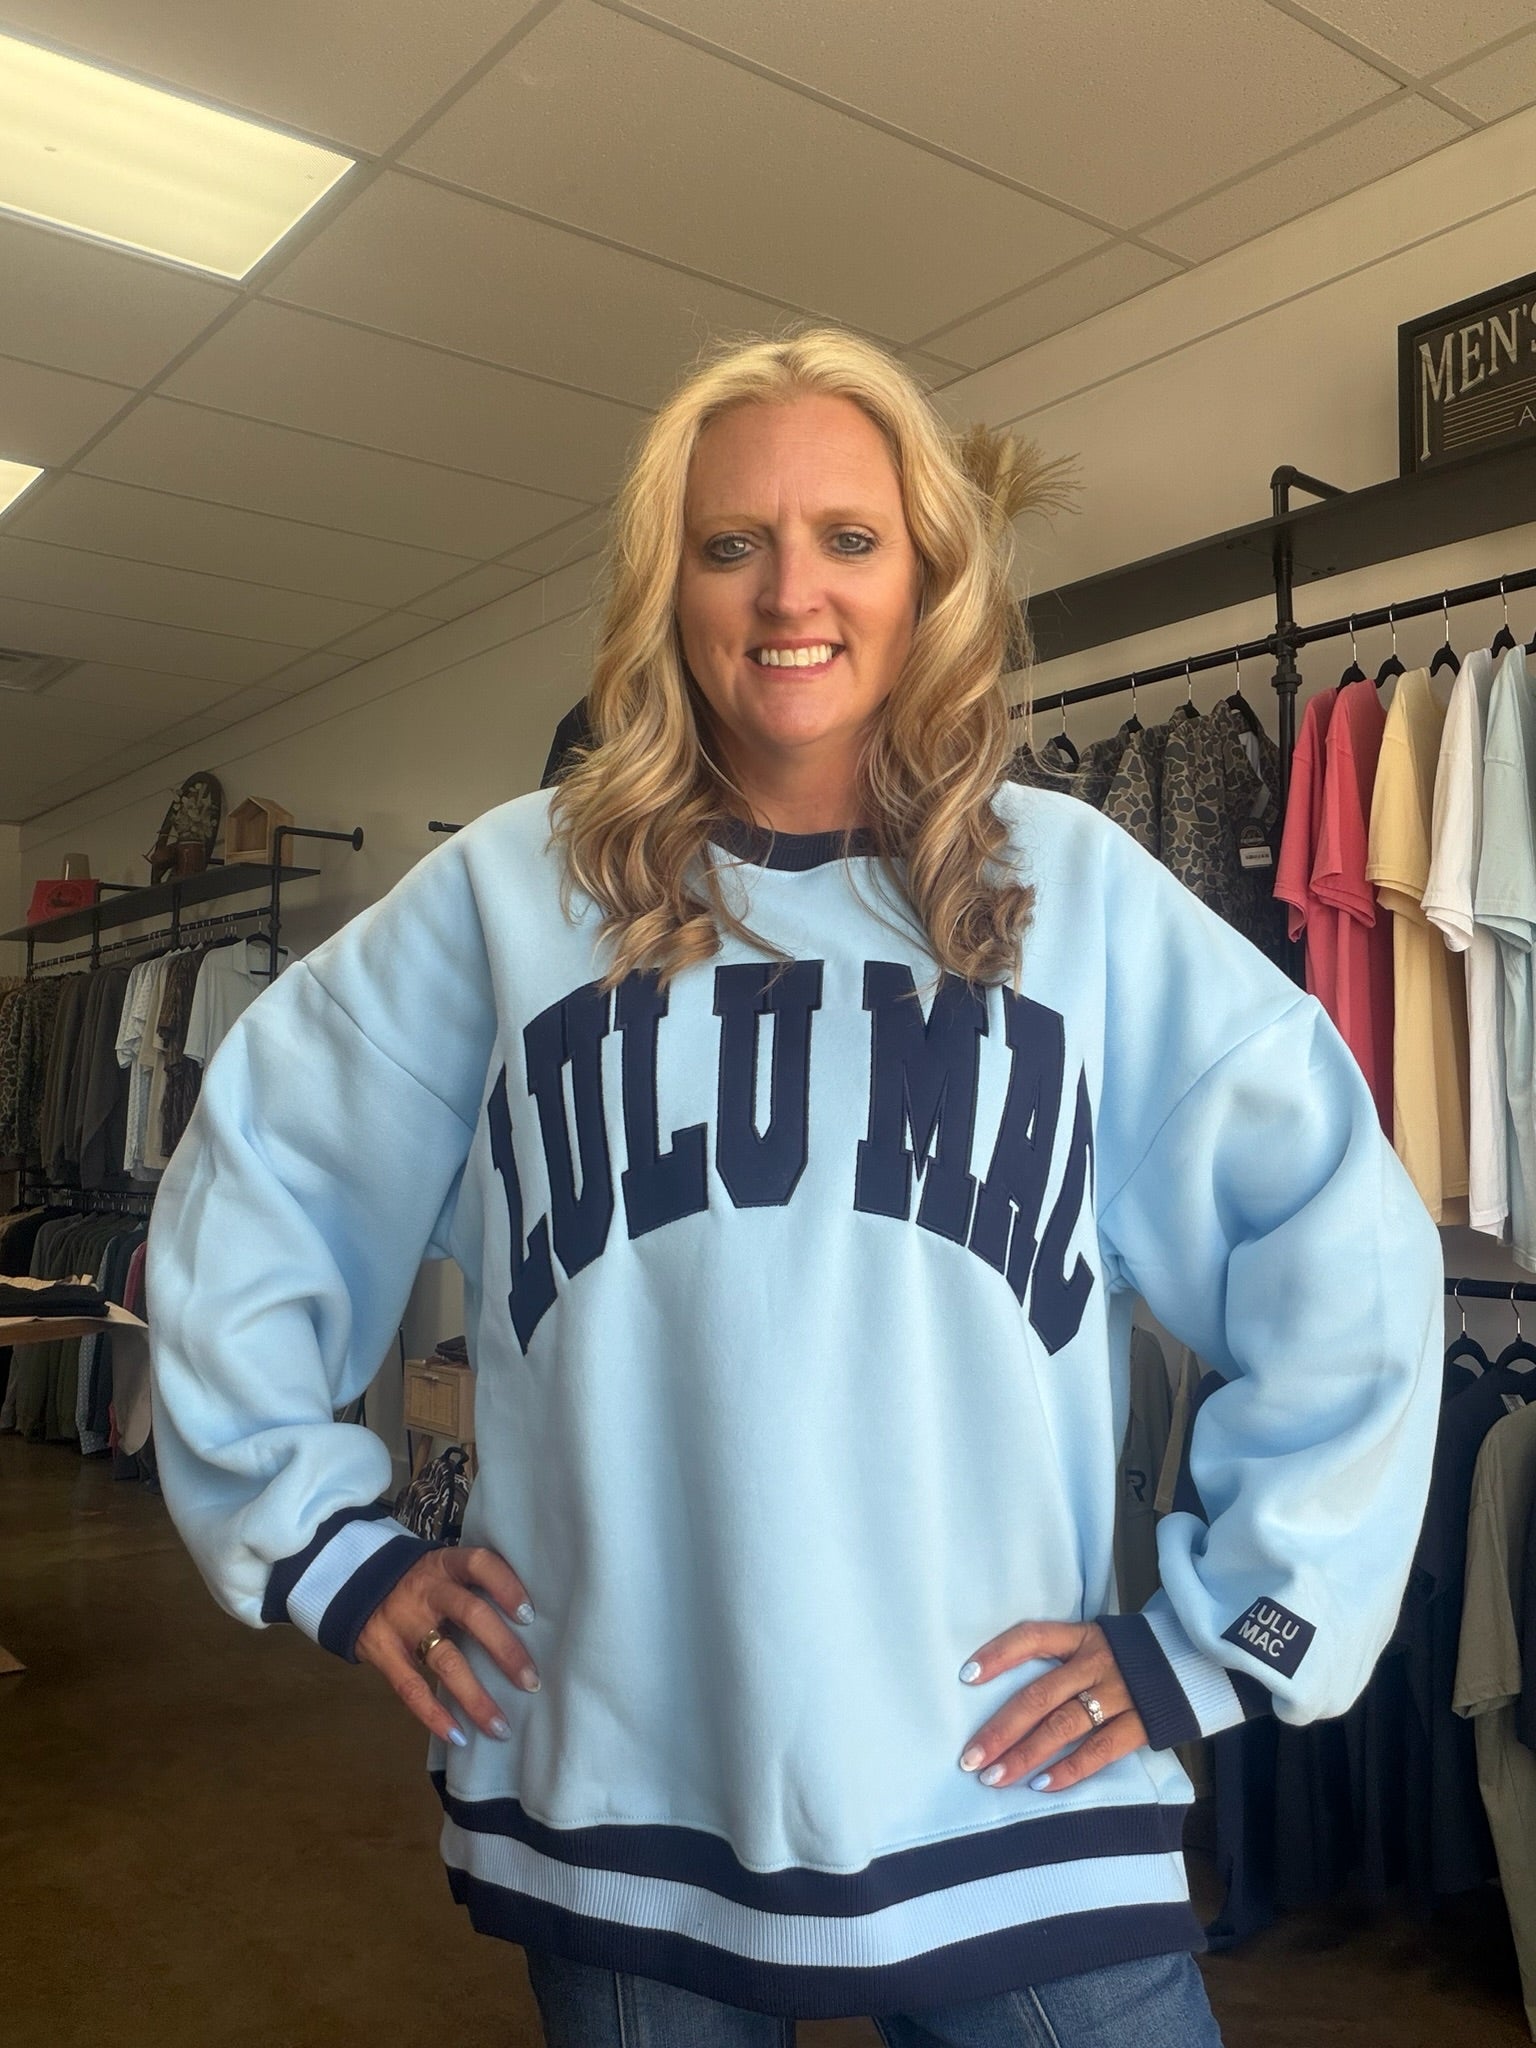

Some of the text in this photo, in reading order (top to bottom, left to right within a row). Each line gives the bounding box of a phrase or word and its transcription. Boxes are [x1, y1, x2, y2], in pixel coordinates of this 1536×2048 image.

[1418, 302, 1536, 462] MEN'
[487, 959, 1095, 1356] LULU MAC
[1238, 1620, 1284, 1657] MAC
[1248, 1602, 1300, 1640] LULU
